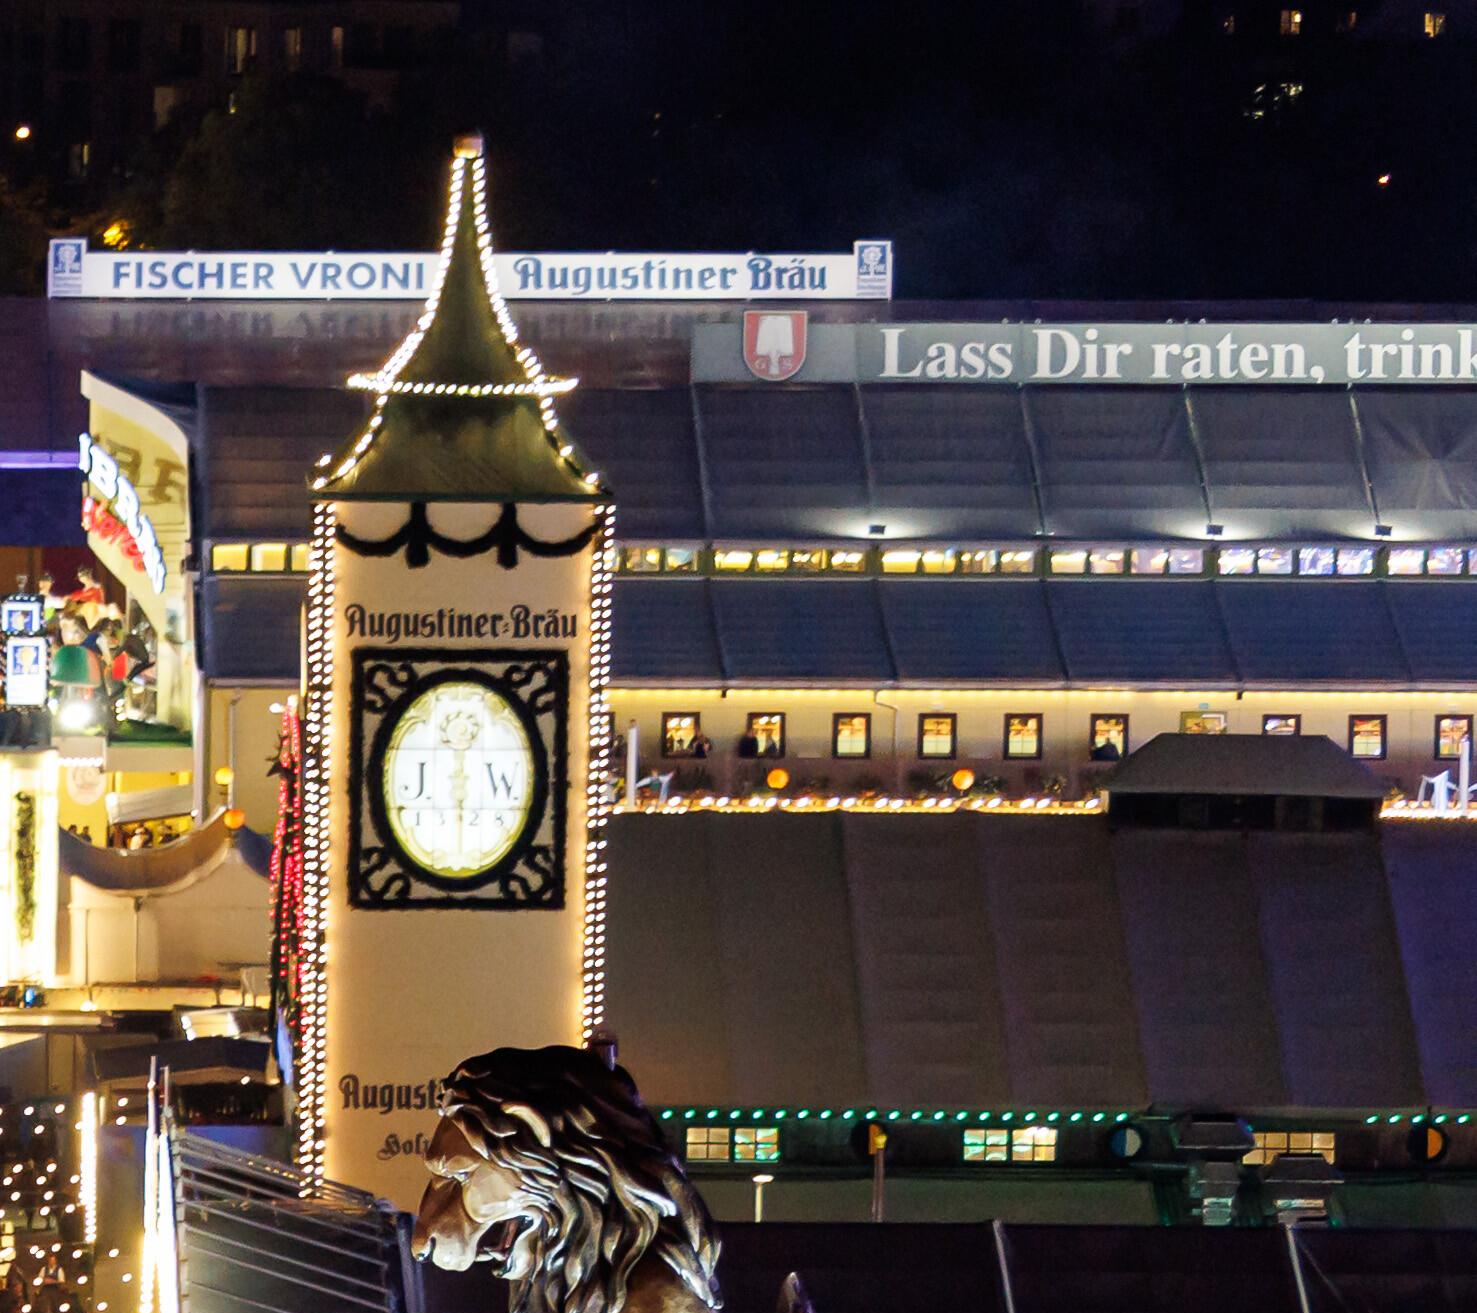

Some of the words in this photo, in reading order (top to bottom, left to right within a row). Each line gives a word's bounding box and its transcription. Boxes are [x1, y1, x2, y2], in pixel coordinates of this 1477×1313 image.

[111, 262, 275, 291] FISCHER
[292, 262, 427, 290] VRONI
[513, 255, 738, 296] Augustiner
[748, 256, 828, 291] Bräu
[879, 327, 1013, 379] Lass
[1031, 327, 1132, 379] Dir
[1151, 331, 1325, 384] raten,
